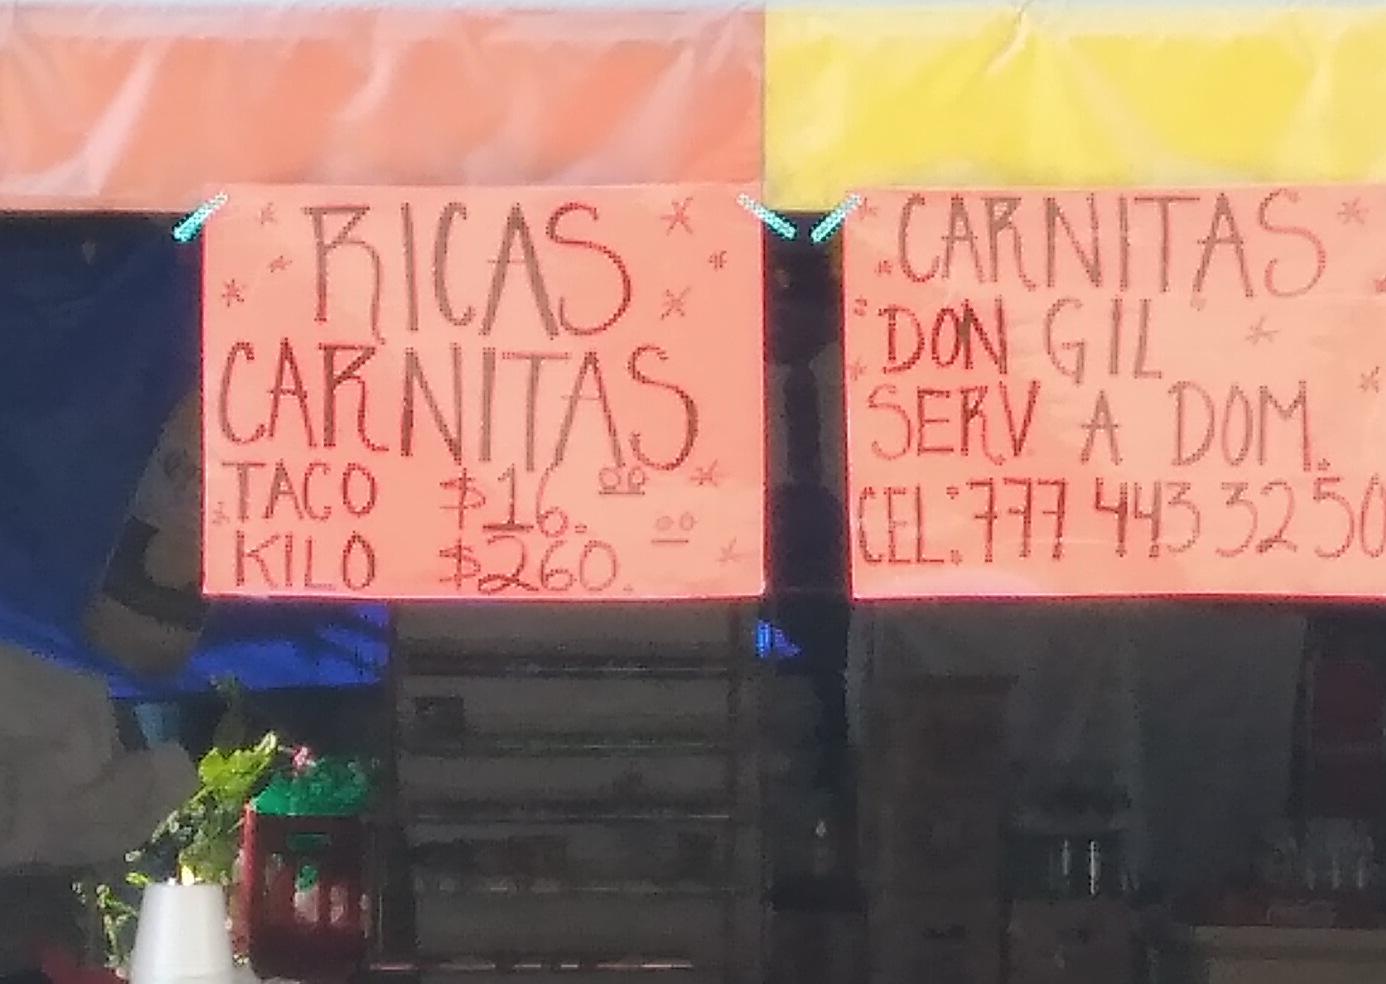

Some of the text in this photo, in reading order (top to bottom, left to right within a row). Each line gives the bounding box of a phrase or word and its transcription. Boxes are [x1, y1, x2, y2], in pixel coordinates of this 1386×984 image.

[303, 202, 631, 345] RICAS
[898, 189, 1327, 297] CARNITAS
[879, 296, 1163, 384] DON GIL
[219, 338, 699, 471] CARNITAS
[868, 380, 1041, 465] SERV
[1081, 390, 1123, 464] A
[222, 460, 377, 522] TACO
[235, 531, 377, 591] KILO
